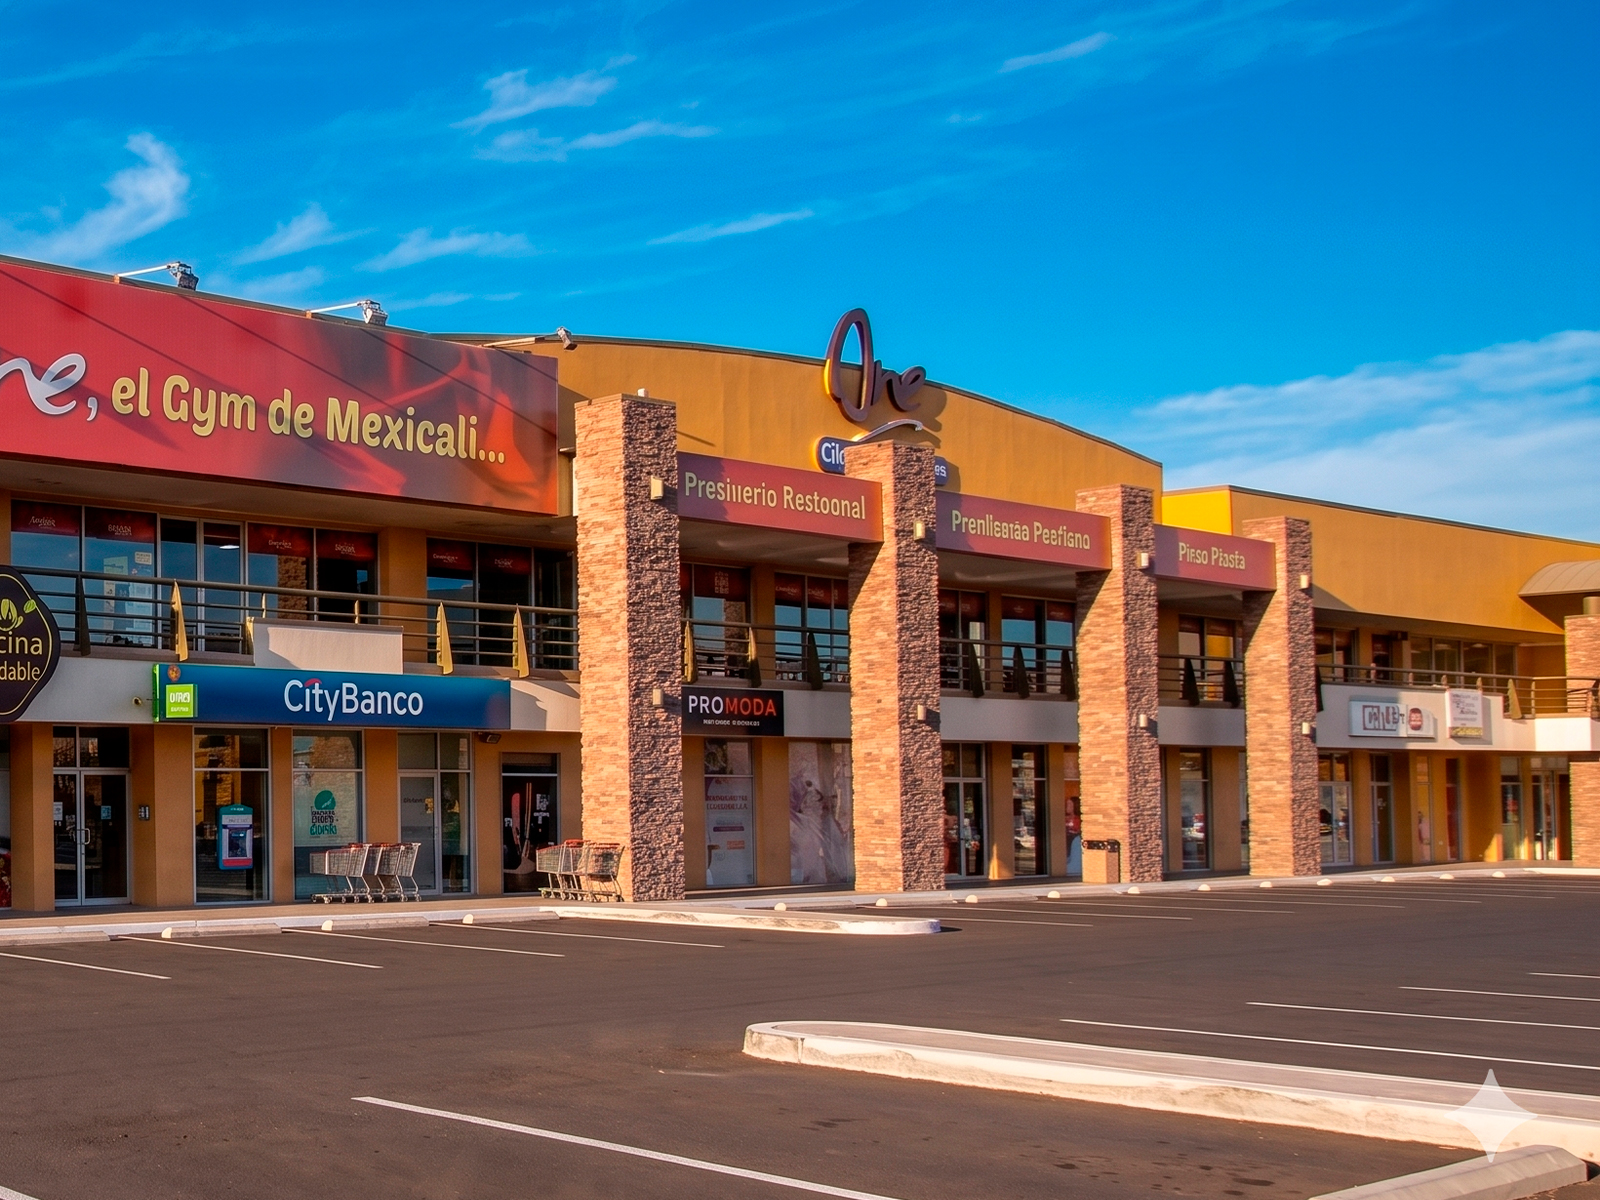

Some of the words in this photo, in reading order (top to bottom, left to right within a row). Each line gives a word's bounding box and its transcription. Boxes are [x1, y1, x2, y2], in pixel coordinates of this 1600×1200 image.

[111, 367, 150, 418] el
[161, 374, 256, 438] Gym
[268, 388, 314, 438] de
[326, 397, 506, 464] Mexicali...
[783, 485, 866, 520] Restoonal
[283, 678, 424, 722] CityBanco
[688, 695, 777, 717] PROMODA
